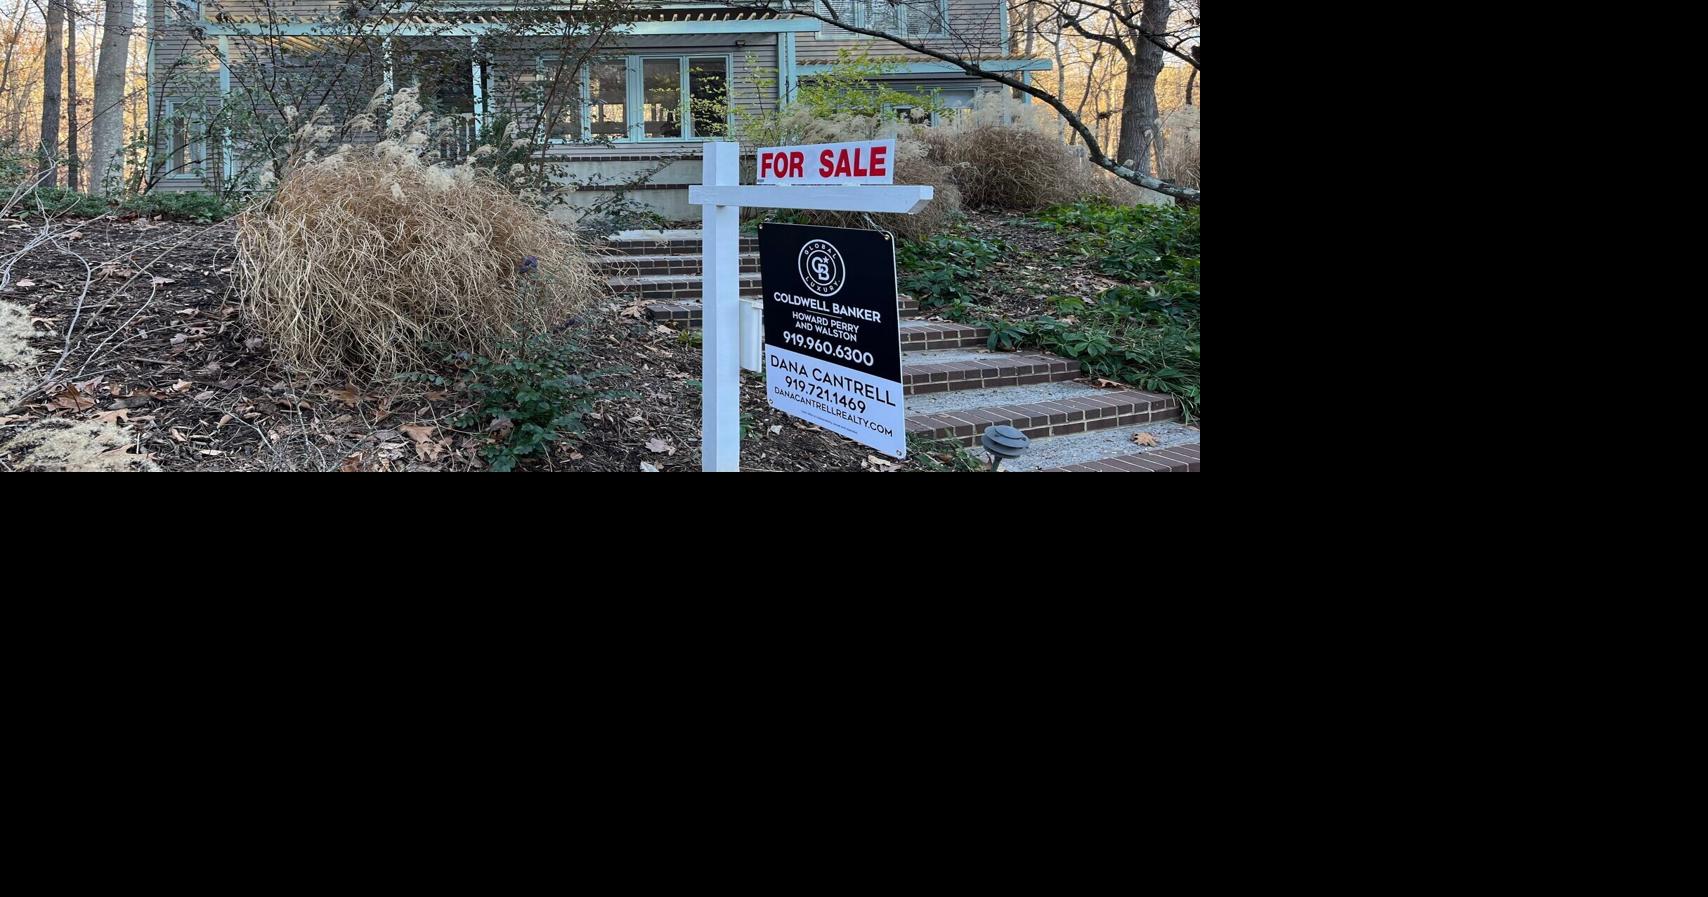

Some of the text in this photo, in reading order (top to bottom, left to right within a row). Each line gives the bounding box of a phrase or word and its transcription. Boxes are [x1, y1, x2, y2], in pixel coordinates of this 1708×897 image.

[761, 146, 887, 178] FOR SALE
[804, 243, 837, 259] GLOBAL
[773, 292, 881, 323] COLDWELL BANKER
[792, 311, 859, 334] HOWARD PERRY
[795, 321, 858, 342] AND WALSTON
[783, 330, 874, 367] 919.960.6300
[771, 355, 896, 407] DANA CANTRELL
[785, 375, 866, 413] 919.721.1469
[774, 386, 893, 437] DANACANTRELLREALTY.COM
